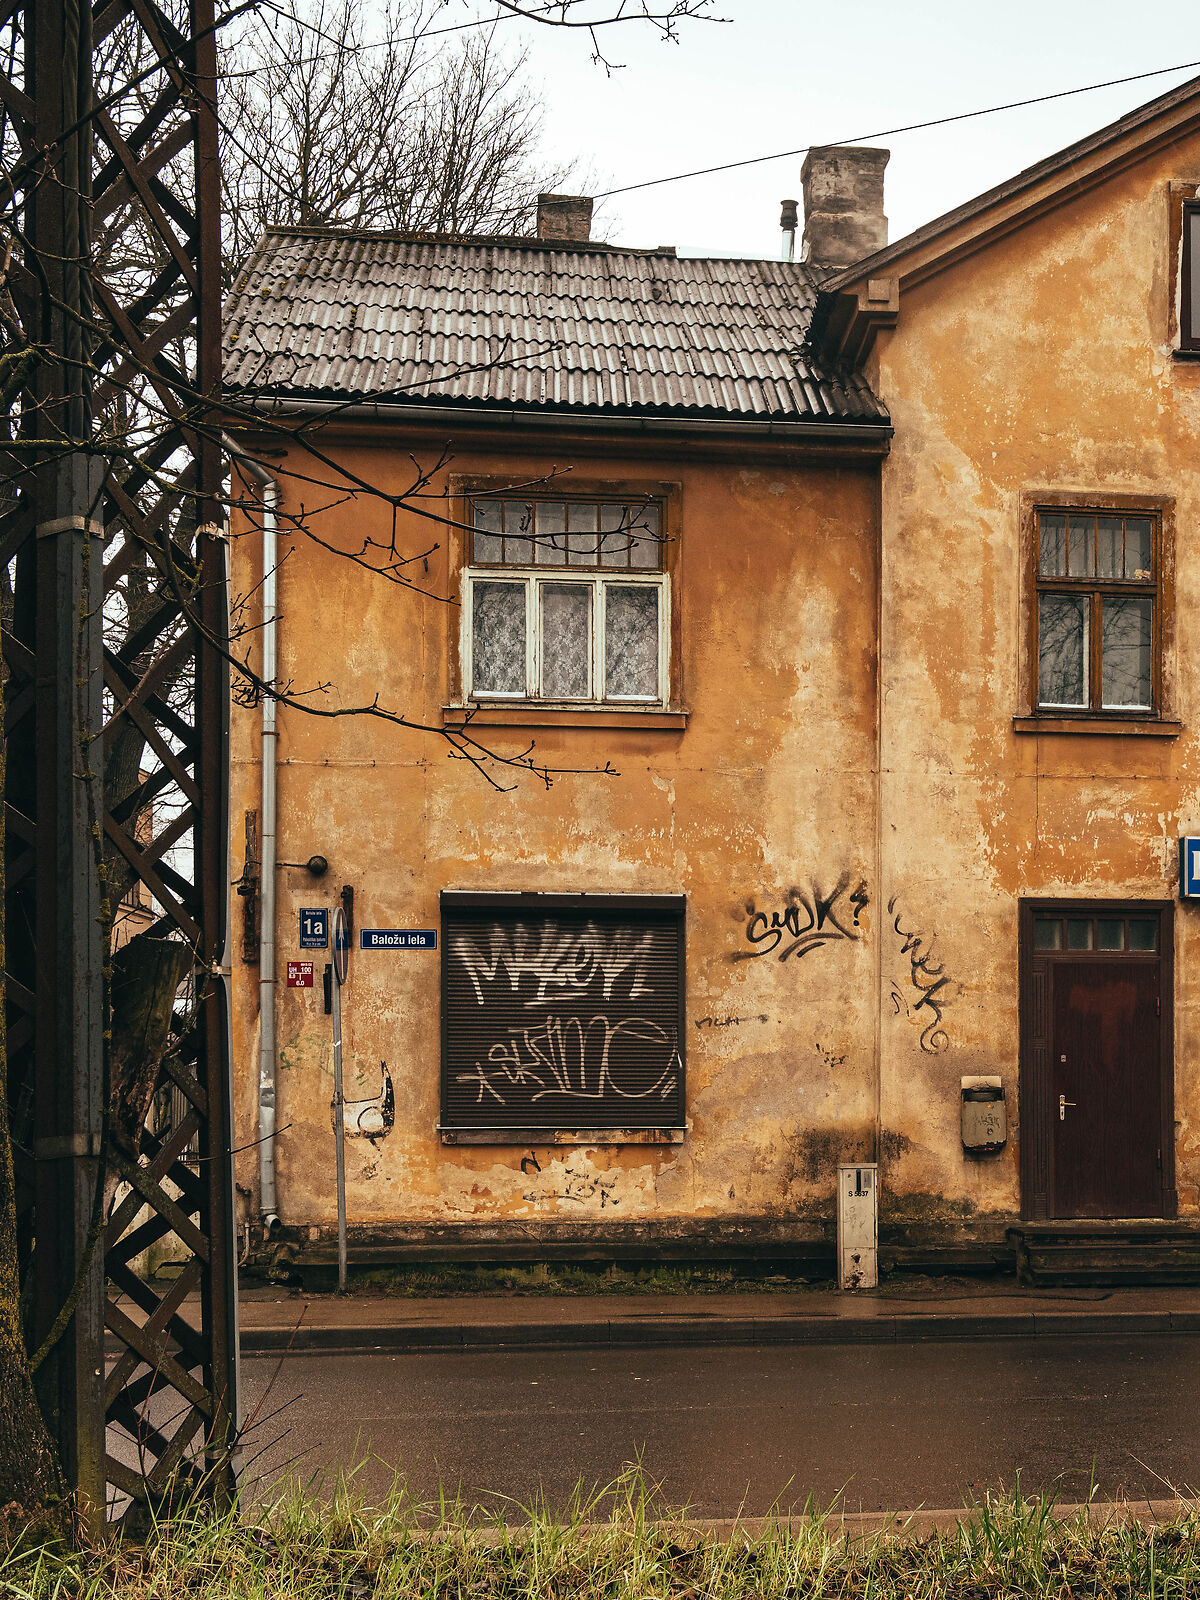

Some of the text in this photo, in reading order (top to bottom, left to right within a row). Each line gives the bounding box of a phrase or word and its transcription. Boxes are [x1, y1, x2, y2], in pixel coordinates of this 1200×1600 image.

[303, 918, 323, 935] 1a
[371, 934, 426, 945] Baložu iela
